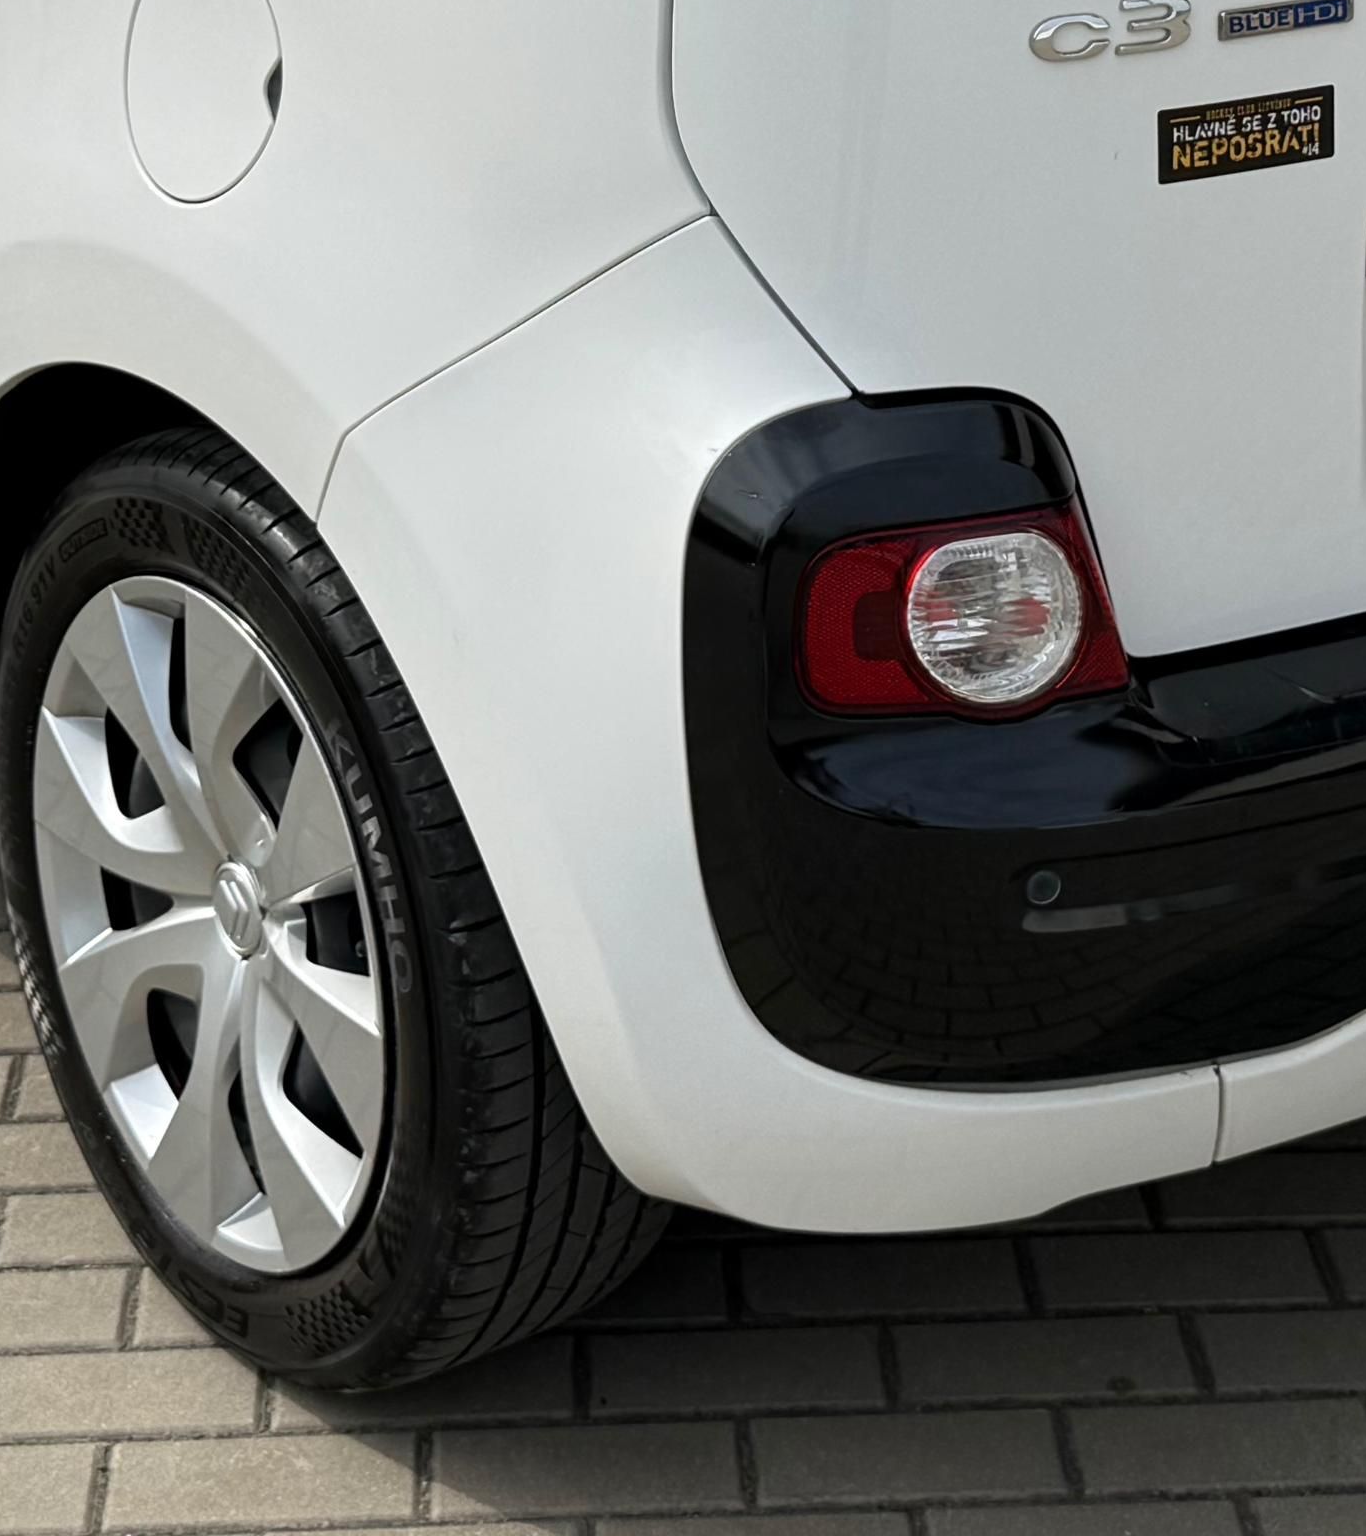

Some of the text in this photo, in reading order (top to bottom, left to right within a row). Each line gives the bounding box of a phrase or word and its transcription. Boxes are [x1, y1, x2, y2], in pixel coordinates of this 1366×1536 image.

[1242, 114, 1262, 132] SE
[1267, 112, 1276, 128] Z
[1281, 105, 1321, 125] TOHO
[1172, 122, 1320, 170] NEPOSRAT!
[326, 719, 413, 992] KUMHO
